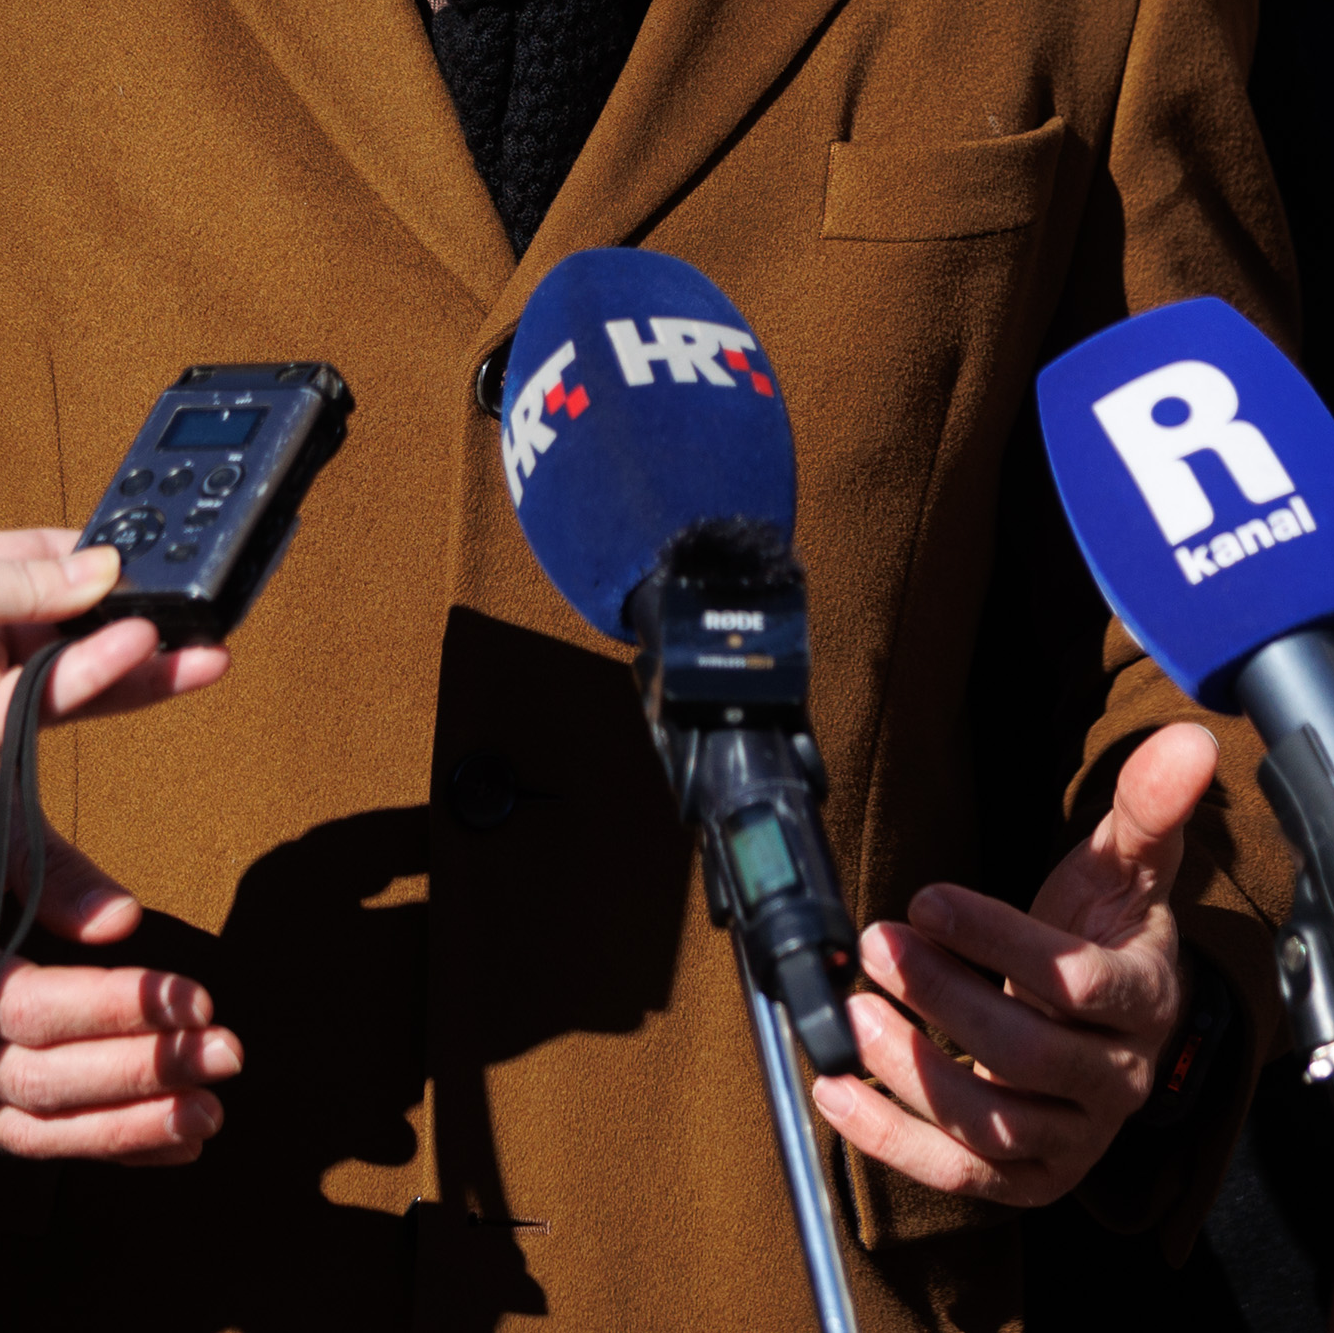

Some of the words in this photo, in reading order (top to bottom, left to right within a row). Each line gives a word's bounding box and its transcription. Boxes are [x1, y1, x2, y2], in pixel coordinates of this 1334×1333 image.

[605, 317, 774, 397] HRT
[502, 340, 590, 508] HRT
[1091, 359, 1296, 546] R
[1174, 495, 1317, 585] kanal
